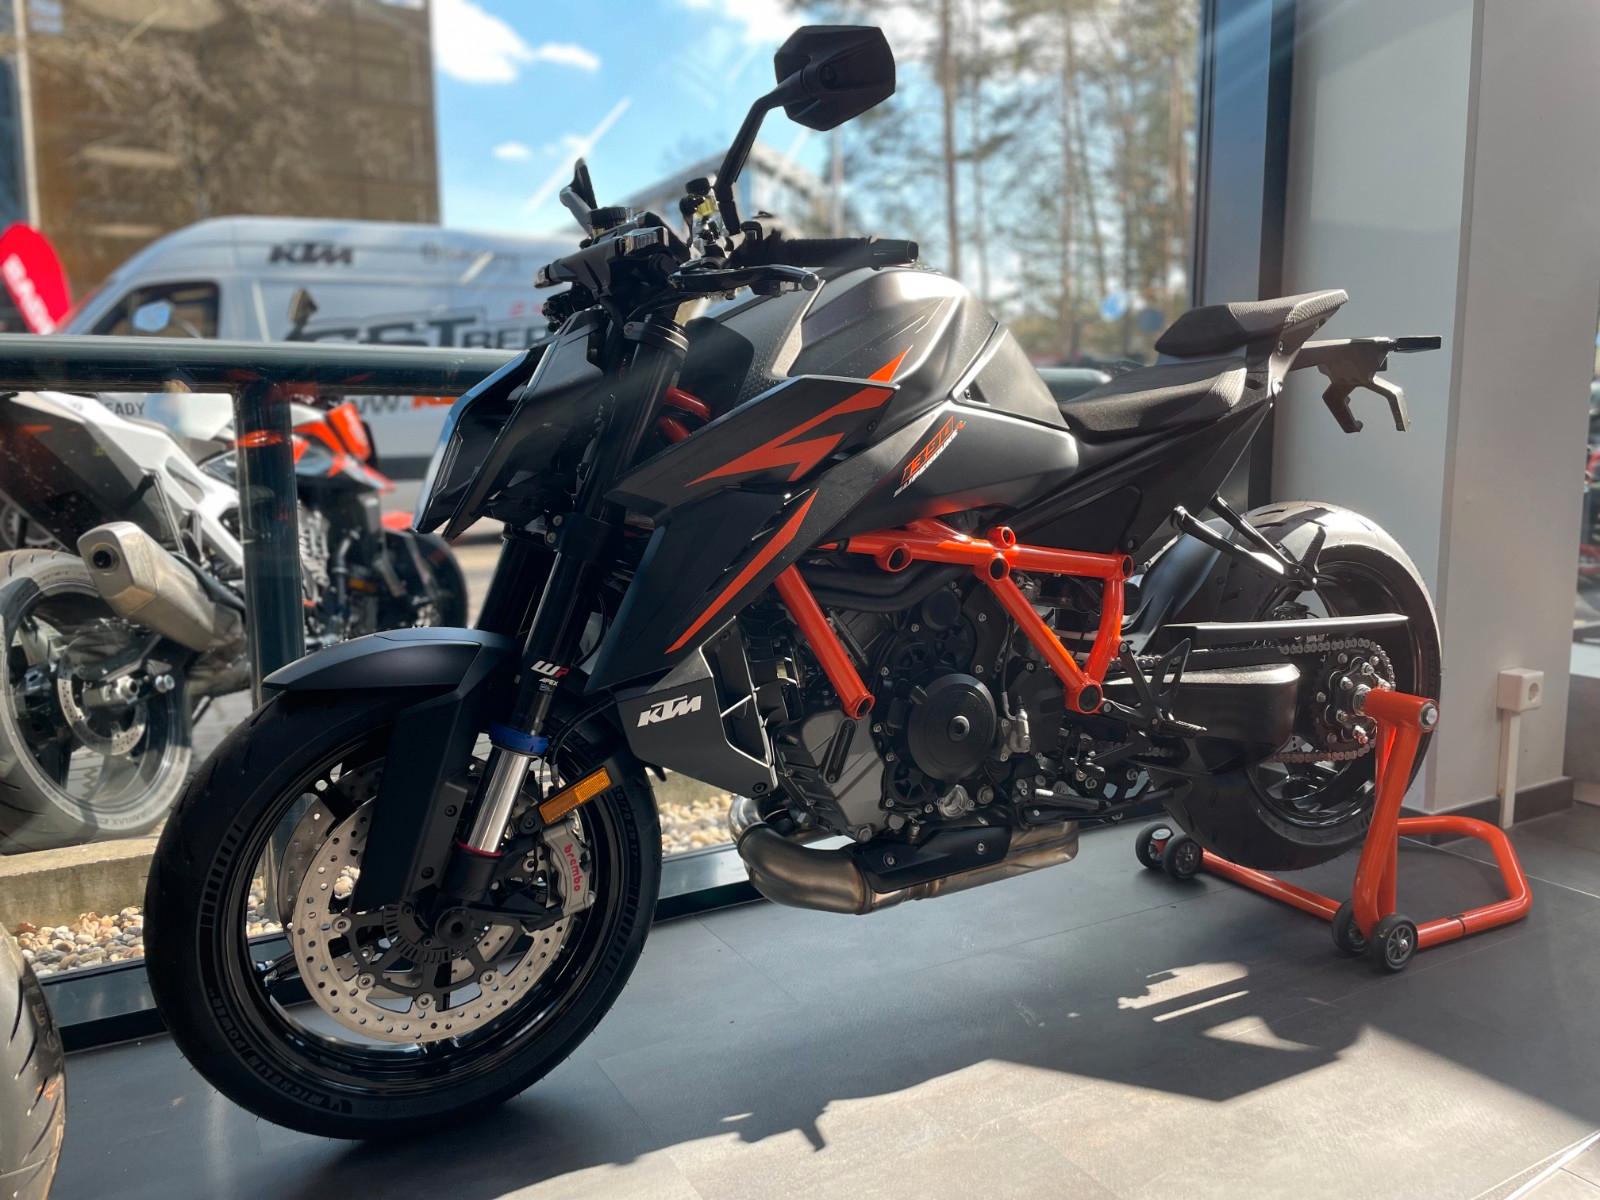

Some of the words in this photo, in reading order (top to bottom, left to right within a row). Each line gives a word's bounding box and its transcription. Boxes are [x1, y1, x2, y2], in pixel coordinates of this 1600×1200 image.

[268, 243, 353, 264] KTM
[103, 401, 145, 416] EADY
[637, 695, 702, 727] KTM
[564, 843, 583, 892] brembo
